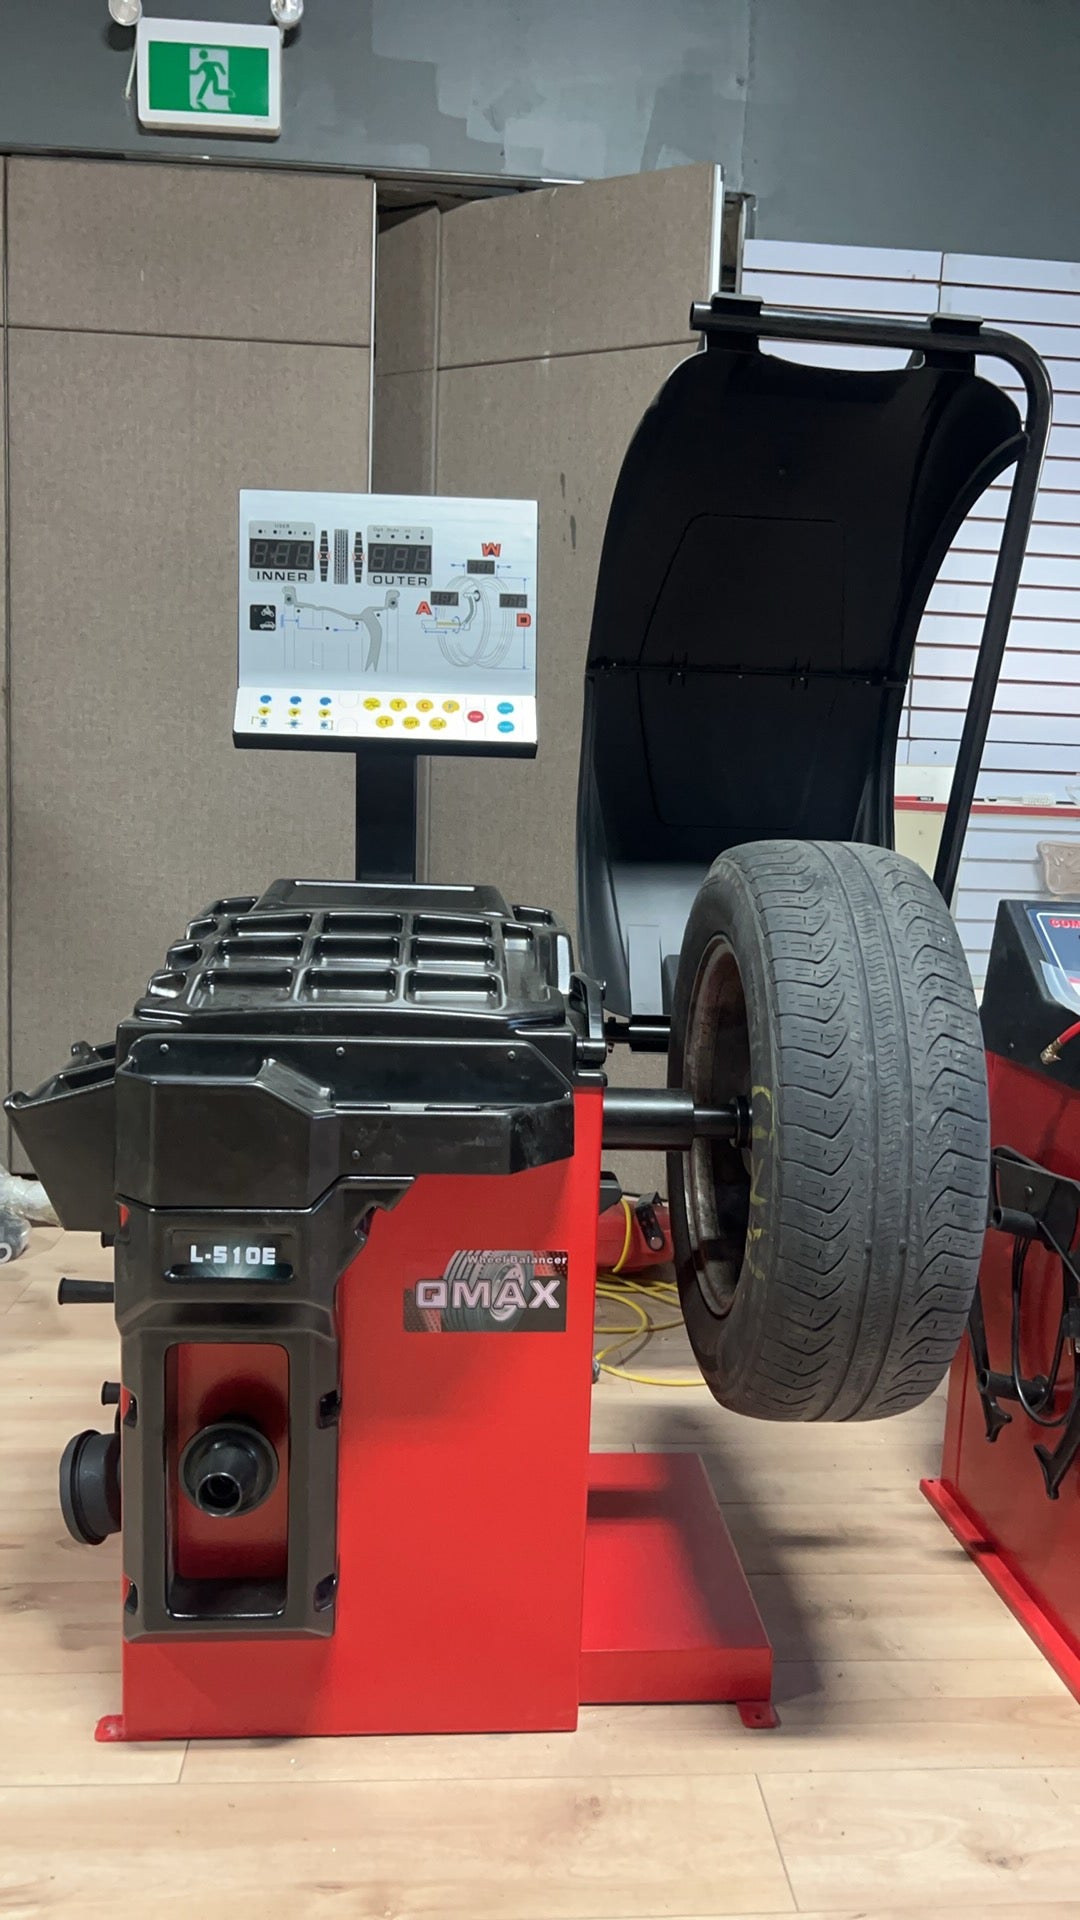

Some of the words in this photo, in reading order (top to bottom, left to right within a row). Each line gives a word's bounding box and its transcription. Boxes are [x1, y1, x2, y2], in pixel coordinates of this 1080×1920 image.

[481, 542, 501, 557] W
[256, 570, 308, 582] INNER
[372, 575, 428, 586] OUTER
[415, 600, 433, 615] A
[516, 612, 532, 628] D
[190, 1244, 276, 1265] L-510E
[466, 1255, 507, 1265] Wheel
[510, 1255, 568, 1266] Balancer
[415, 1279, 564, 1309] QMAX
